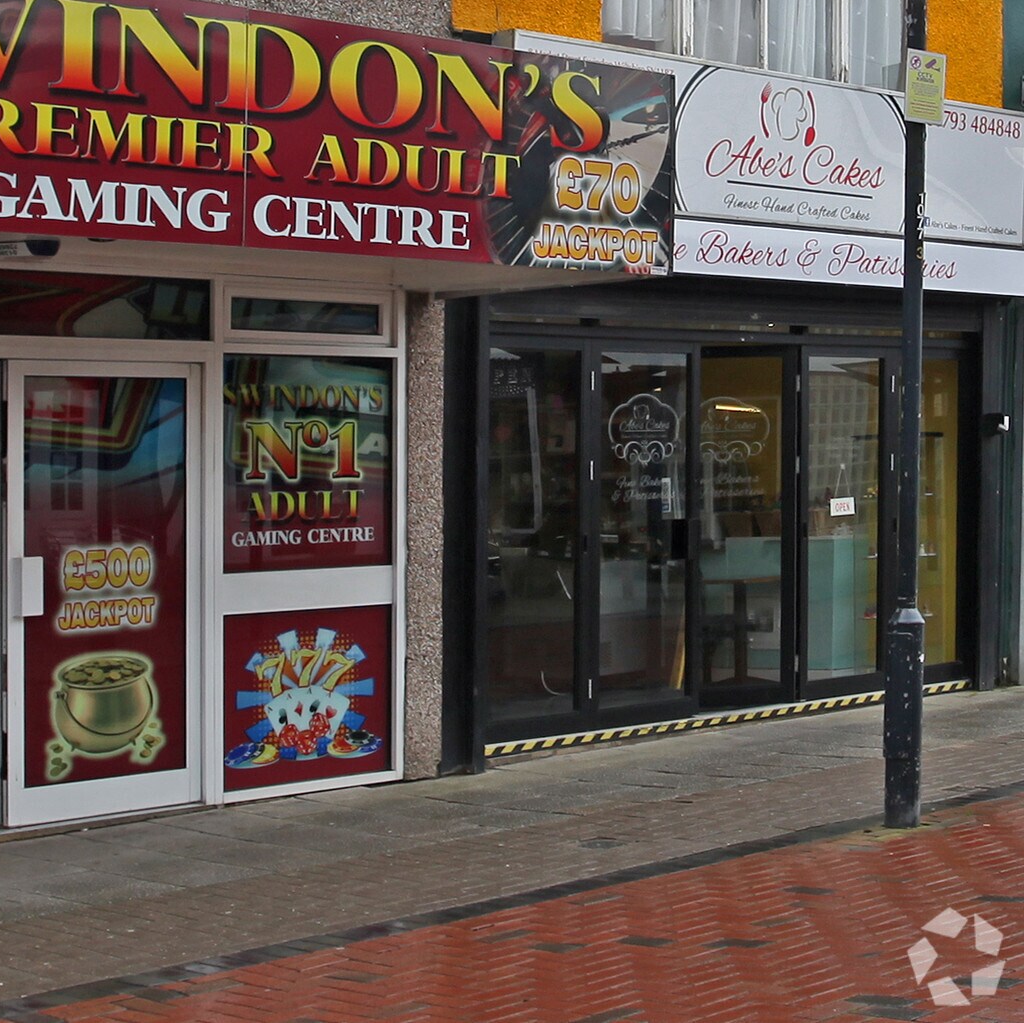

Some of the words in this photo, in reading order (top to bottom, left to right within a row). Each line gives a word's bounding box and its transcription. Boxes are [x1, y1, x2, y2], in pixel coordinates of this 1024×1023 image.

[943, 110, 966, 131] 793
[971, 115, 1021, 139] 484848
[306, 133, 520, 198] ADULT
[705, 135, 796, 179] Abe's
[803, 145, 885, 189] Cakes
[557, 157, 640, 215] £70
[254, 194, 471, 250] CENTRE
[723, 193, 759, 209] Finest
[761, 197, 795, 214] Hand
[797, 202, 838, 218] Crafted
[840, 206, 871, 221] Cakes
[533, 224, 658, 263] JACKPOT
[696, 229, 790, 267] Bakers
[797, 238, 822, 275] &
[828, 242, 959, 280] Patisries
[245, 490, 364, 521] ADULT
[835, 502, 850, 512] OPEN
[232, 530, 301, 547] GAMING
[308, 526, 374, 544] CENTRE
[63, 546, 151, 591] £500
[58, 597, 155, 631] JACKPOT
